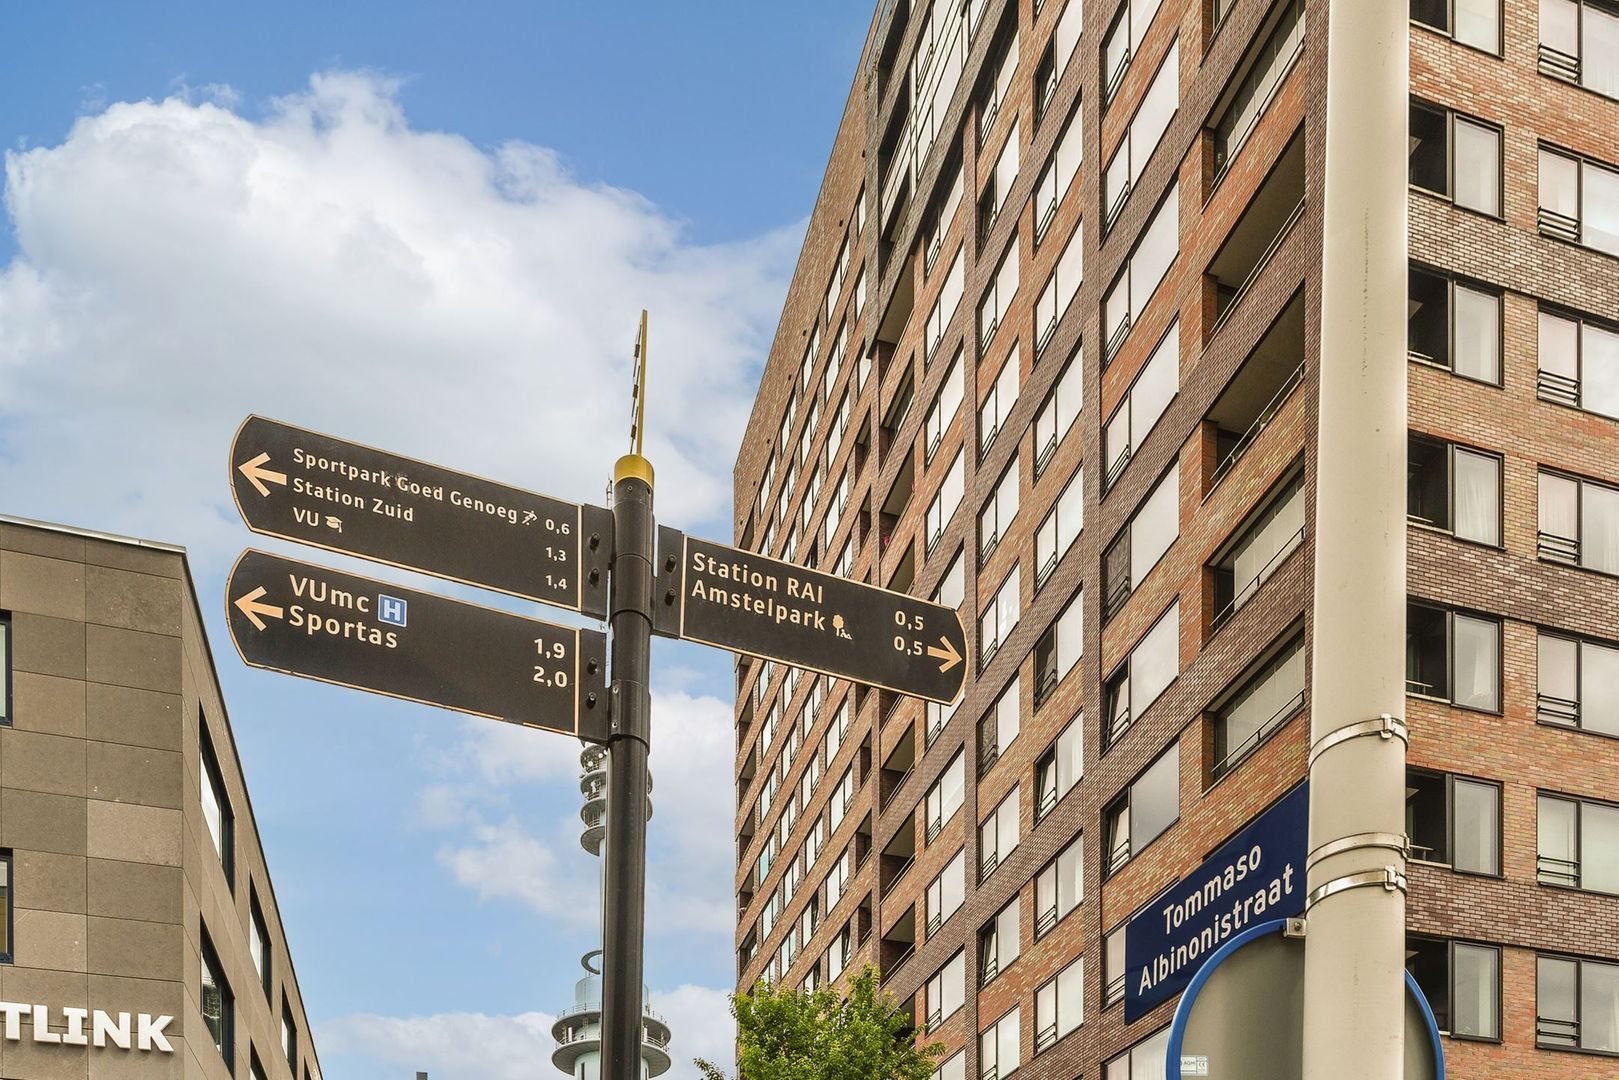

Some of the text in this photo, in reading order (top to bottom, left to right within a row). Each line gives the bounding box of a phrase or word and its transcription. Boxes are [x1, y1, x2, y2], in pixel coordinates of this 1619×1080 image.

[293, 448, 570, 535] Sportpark Goed Genoeg 0,6
[293, 477, 567, 562] Station Zuid 1,3
[292, 506, 568, 590] VU 1,4
[289, 573, 370, 613] VUmc
[534, 638, 566, 659] 1,9
[691, 579, 923, 656] Amstelpark 0,5
[692, 552, 924, 631] Station RAI 0,5
[288, 604, 568, 688] Sportas 2,0
[1138, 863, 1294, 996] Albinonistraat
[1163, 845, 1262, 935] Tommaso
[0, 1002, 174, 1052] TLINK
